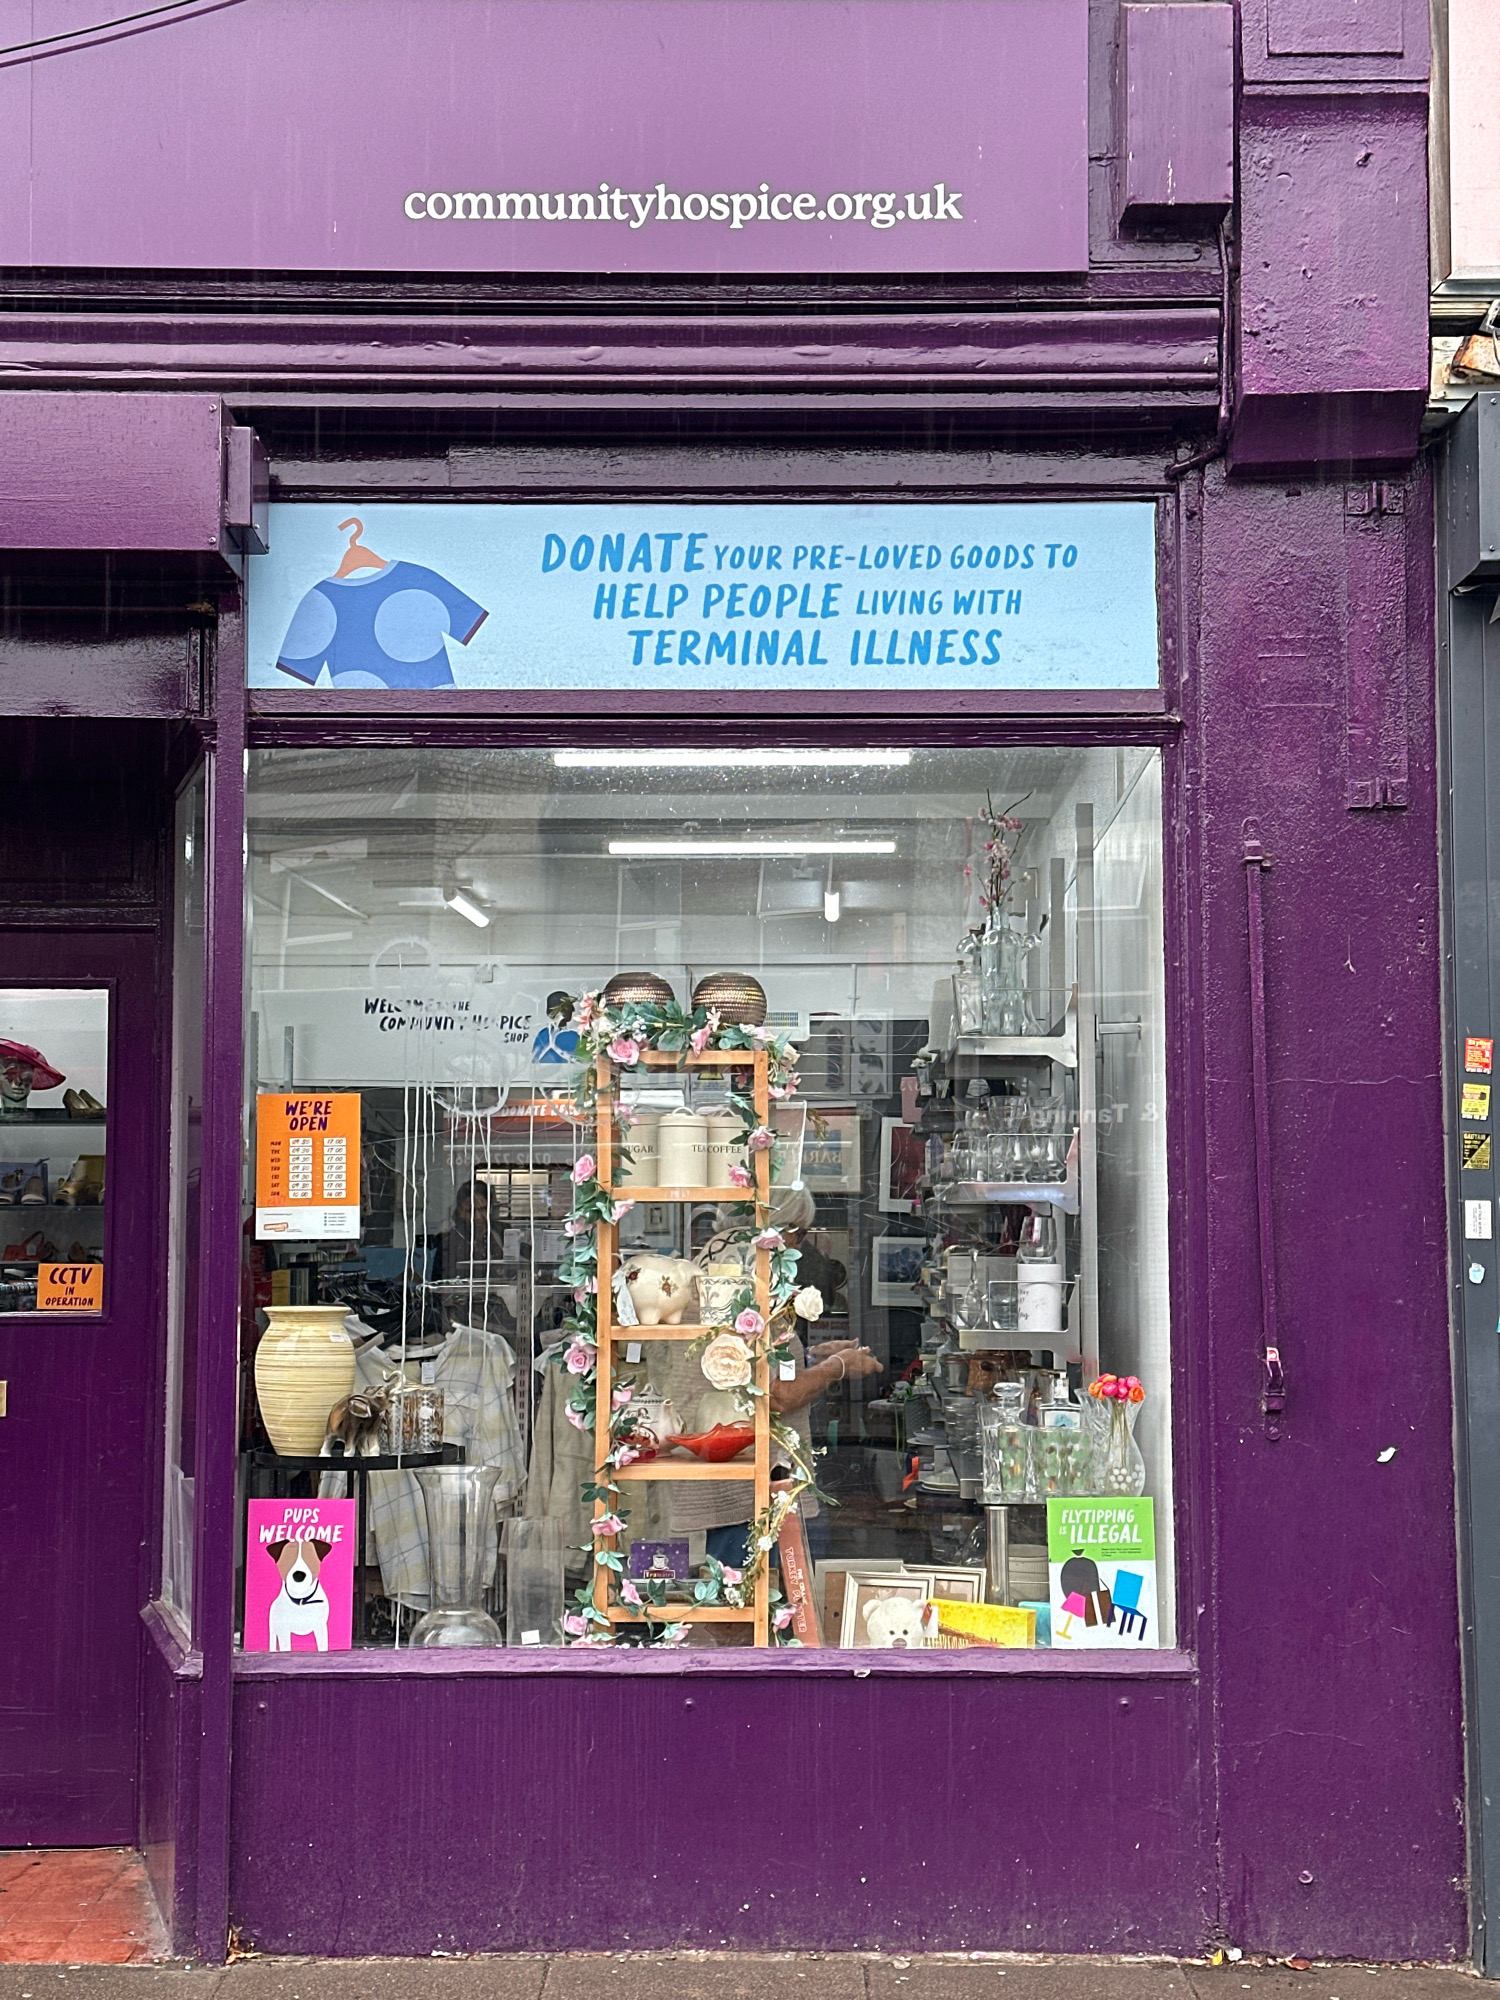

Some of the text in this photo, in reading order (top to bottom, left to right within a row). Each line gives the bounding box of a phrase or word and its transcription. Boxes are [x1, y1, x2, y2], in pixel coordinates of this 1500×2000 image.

[403, 183, 963, 229] communityhospice.org.uk
[542, 533, 1078, 573] DONATE YOUR PRE-LOVED GOODS TO
[593, 582, 1022, 619] HELP PEOPLE LIVING WITH
[628, 629, 1002, 666] TERMINAL ILLNESS
[504, 1032, 529, 1043] SHOP
[286, 1100, 333, 1116] WE'RE
[501, 1104, 548, 1117] DONATE
[289, 1116, 328, 1131] OPEN
[707, 1145, 742, 1154] COFFEE
[49, 1267, 93, 1285] CCTV
[65, 1286, 75, 1295] IN
[45, 1297, 94, 1306] OPERATION
[283, 1508, 320, 1523] PUPS
[1062, 1509, 1135, 1524] FLYTIPPING
[259, 1525, 344, 1543] WELCOME
[1070, 1524, 1142, 1544] ILLEGAL
[785, 1546, 799, 1585] TURKEY
